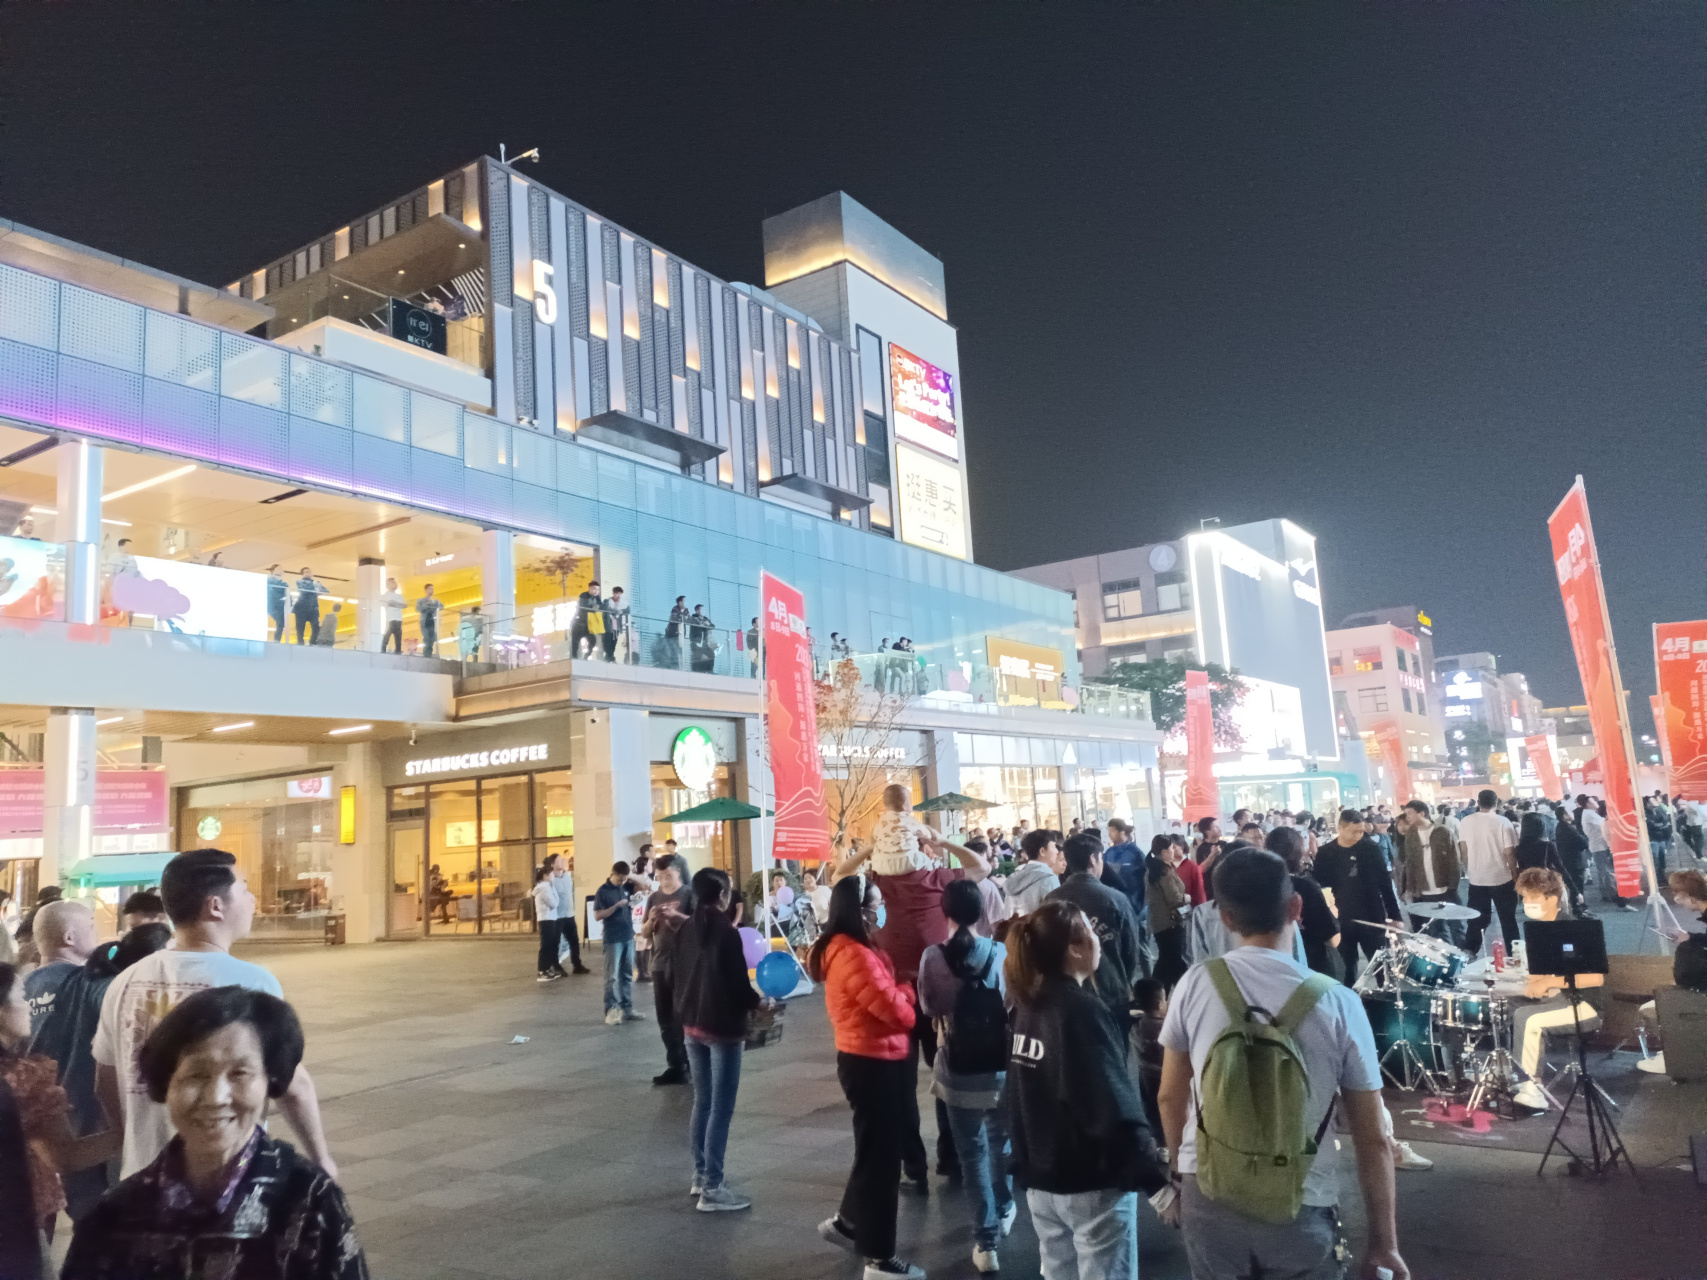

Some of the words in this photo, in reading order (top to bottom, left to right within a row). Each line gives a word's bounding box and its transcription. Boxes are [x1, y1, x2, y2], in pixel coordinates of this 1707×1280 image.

[532, 259, 557, 324] 5
[768, 596, 788, 625] 4月
[1661, 636, 1690, 653] 4月
[405, 751, 490, 776] STARBUCKS
[489, 744, 548, 765] COFFEE
